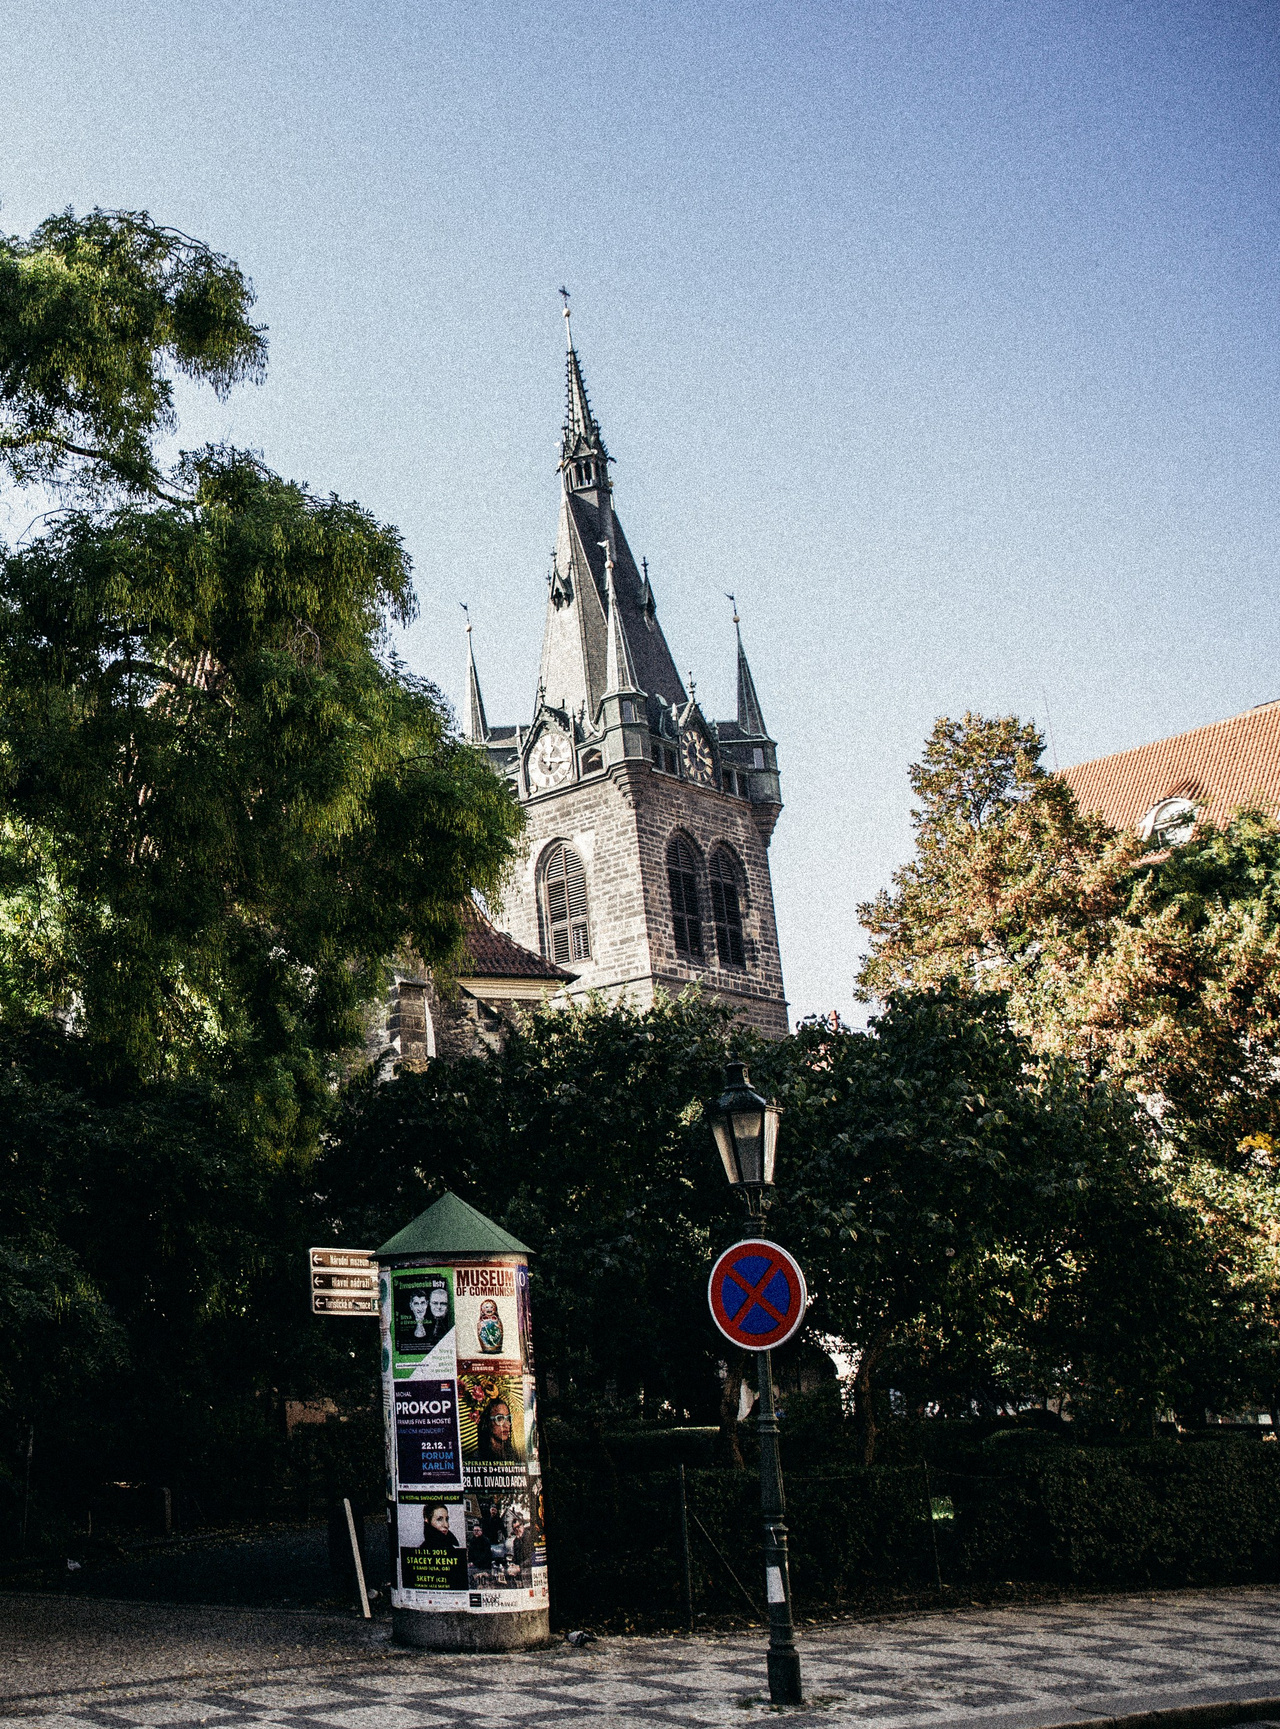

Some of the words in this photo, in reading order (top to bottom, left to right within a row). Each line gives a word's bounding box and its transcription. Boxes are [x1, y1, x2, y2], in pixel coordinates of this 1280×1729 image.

[456, 1270, 514, 1287] MUSEUM
[456, 1287, 468, 1297] OF
[469, 1287, 516, 1297] COMMUNISM
[396, 1400, 452, 1415] PROKOP
[421, 1441, 446, 1450] 22.12.
[421, 1451, 454, 1460] FORUM
[422, 1460, 455, 1470] KARLÍN
[473, 1476, 483, 1488] 10.
[484, 1475, 510, 1488] DIVADLO
[406, 1556, 433, 1565] STACEY
[435, 1557, 459, 1566] KENT
